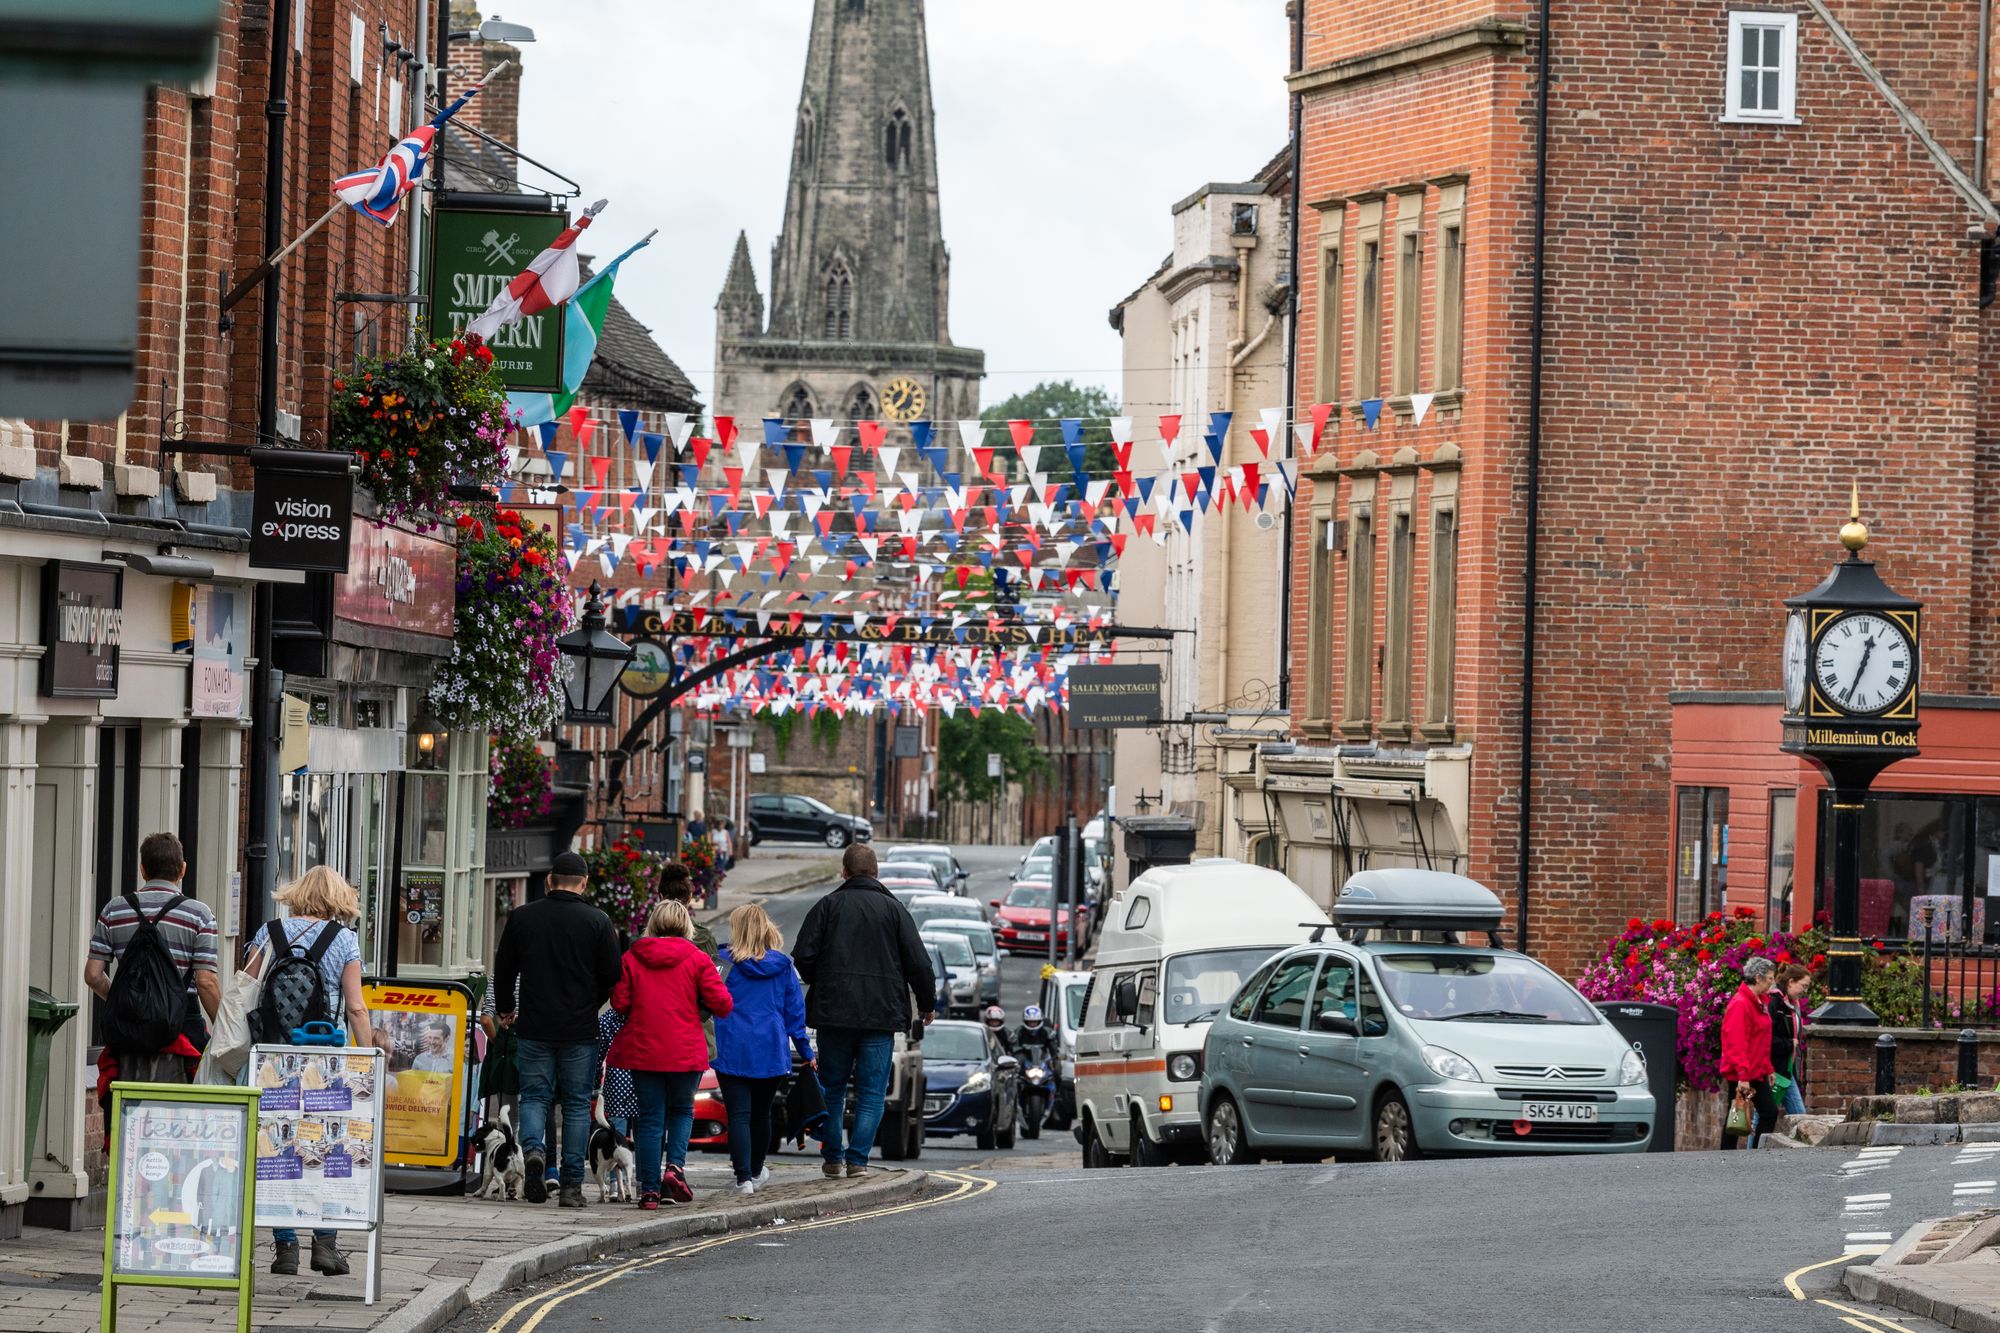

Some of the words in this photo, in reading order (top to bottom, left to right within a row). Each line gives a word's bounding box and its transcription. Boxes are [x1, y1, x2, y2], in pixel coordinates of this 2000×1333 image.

[274, 497, 332, 519] vision
[261, 520, 341, 542] express
[64, 605, 90, 644] vision
[1071, 683, 1101, 693] SALLY
[1103, 682, 1158, 692] MONTAGUE
[1808, 729, 1878, 746] Millennium
[1881, 730, 1917, 747] Clock
[382, 992, 441, 1008] DHL
[1529, 1104, 1563, 1119] SK54
[1568, 1105, 1593, 1119] VCD
